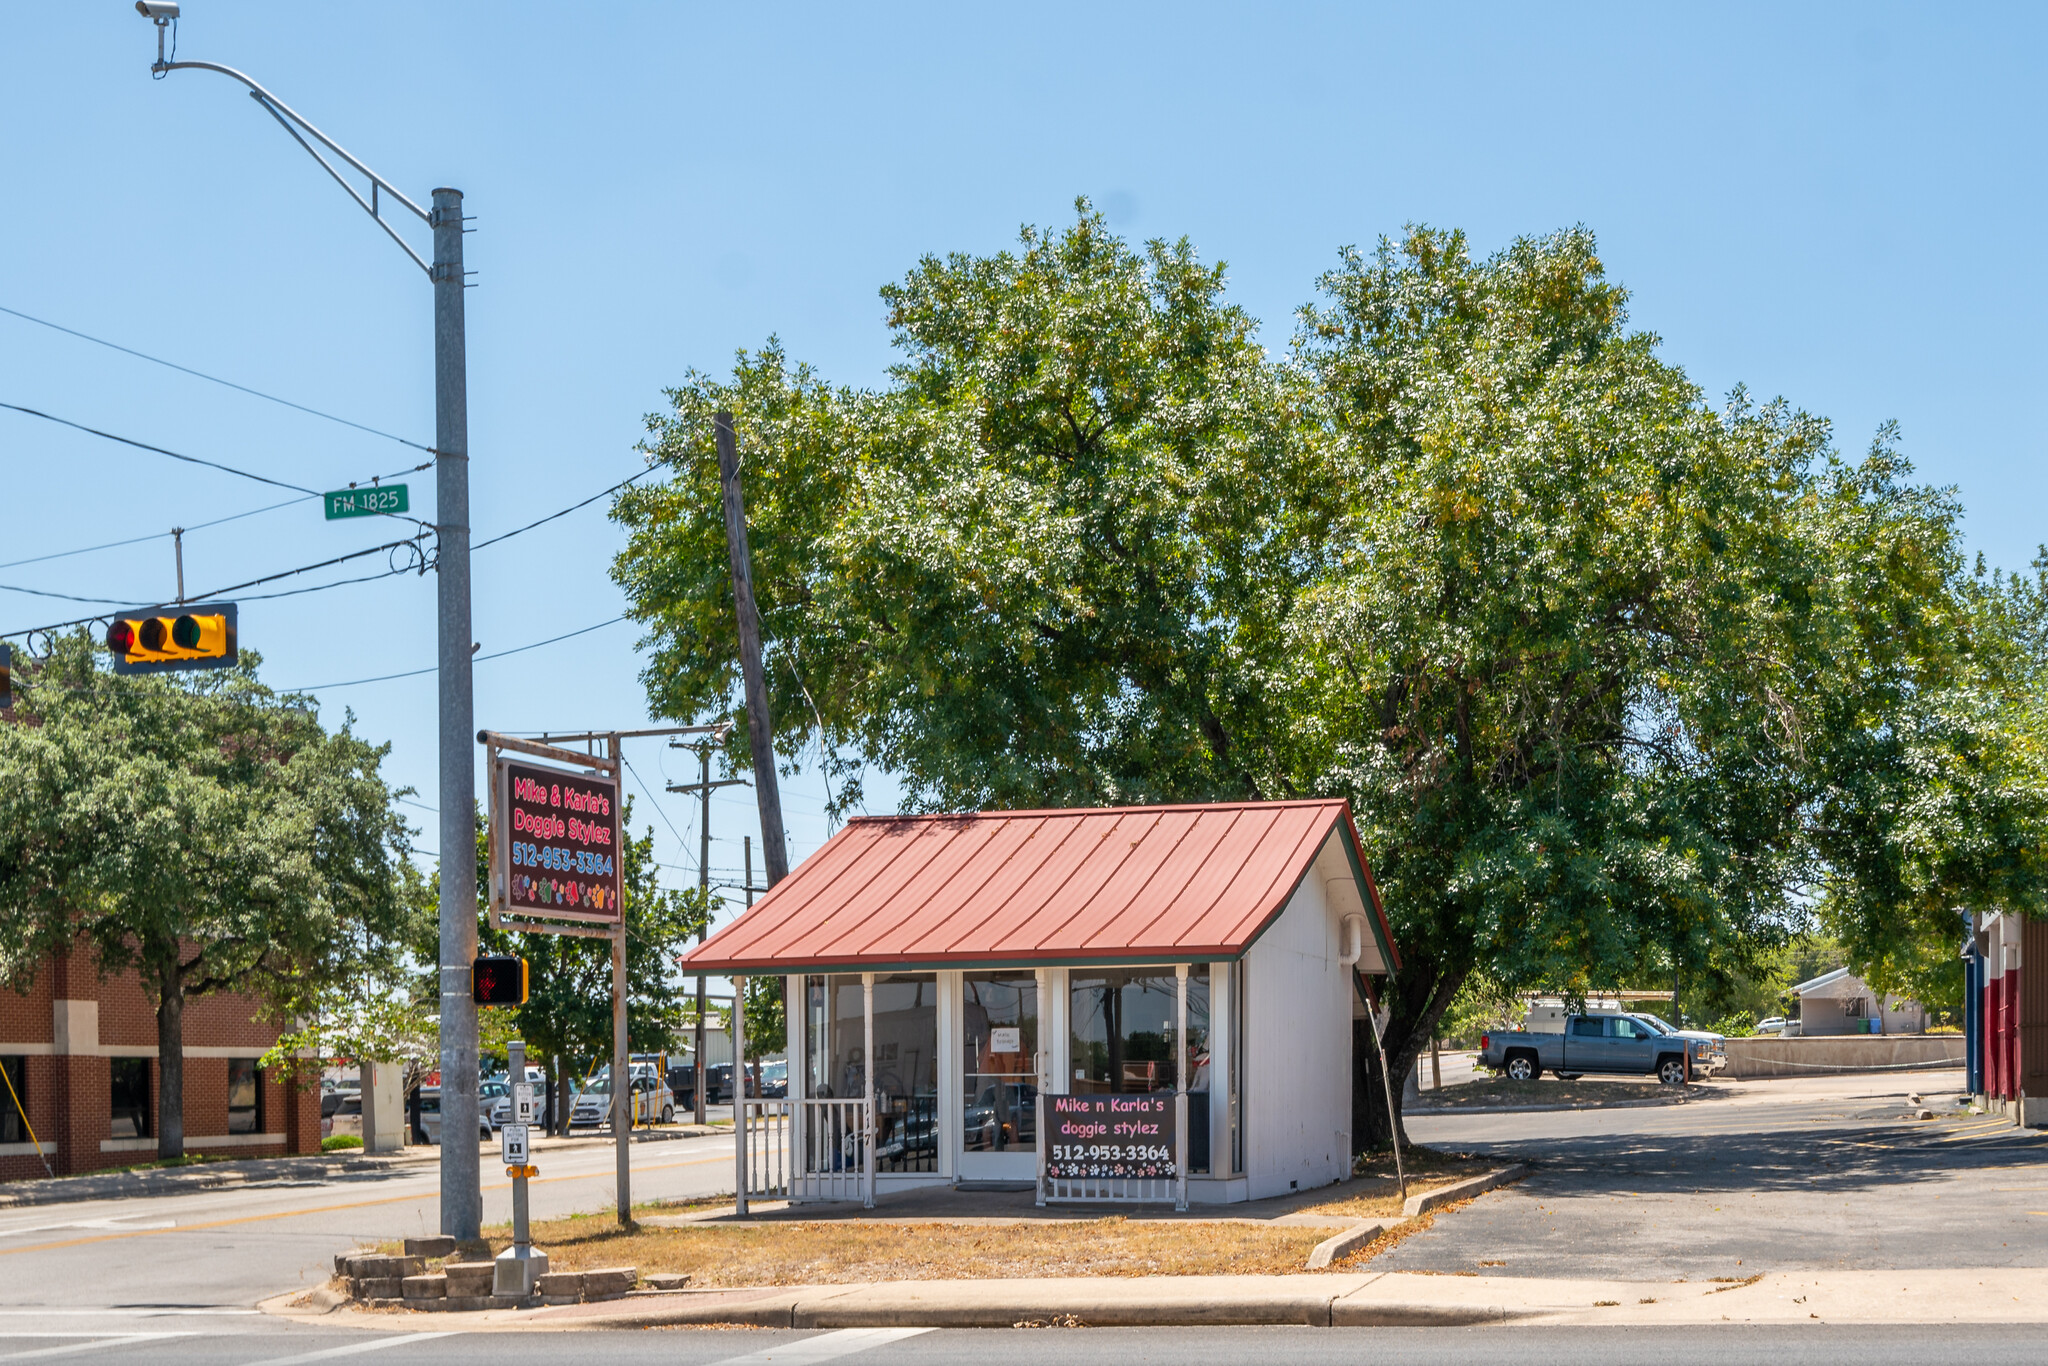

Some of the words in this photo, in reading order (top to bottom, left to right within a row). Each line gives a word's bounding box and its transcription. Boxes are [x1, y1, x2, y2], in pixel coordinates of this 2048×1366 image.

[333, 495, 355, 513] FM
[363, 491, 398, 512] 1825
[514, 776, 548, 805] Mike
[550, 784, 561, 808] &
[564, 786, 610, 816] Karla's
[514, 807, 566, 840] Doggie
[568, 817, 611, 846] Stylez
[512, 841, 614, 877] 512-953-3364
[1055, 1097, 1090, 1113] Mike
[1096, 1102, 1105, 1113] n
[1111, 1097, 1164, 1113] Karla's
[1061, 1120, 1107, 1138] doggie
[1114, 1120, 1159, 1138] stylez
[1052, 1144, 1170, 1161] 512-953-3364
